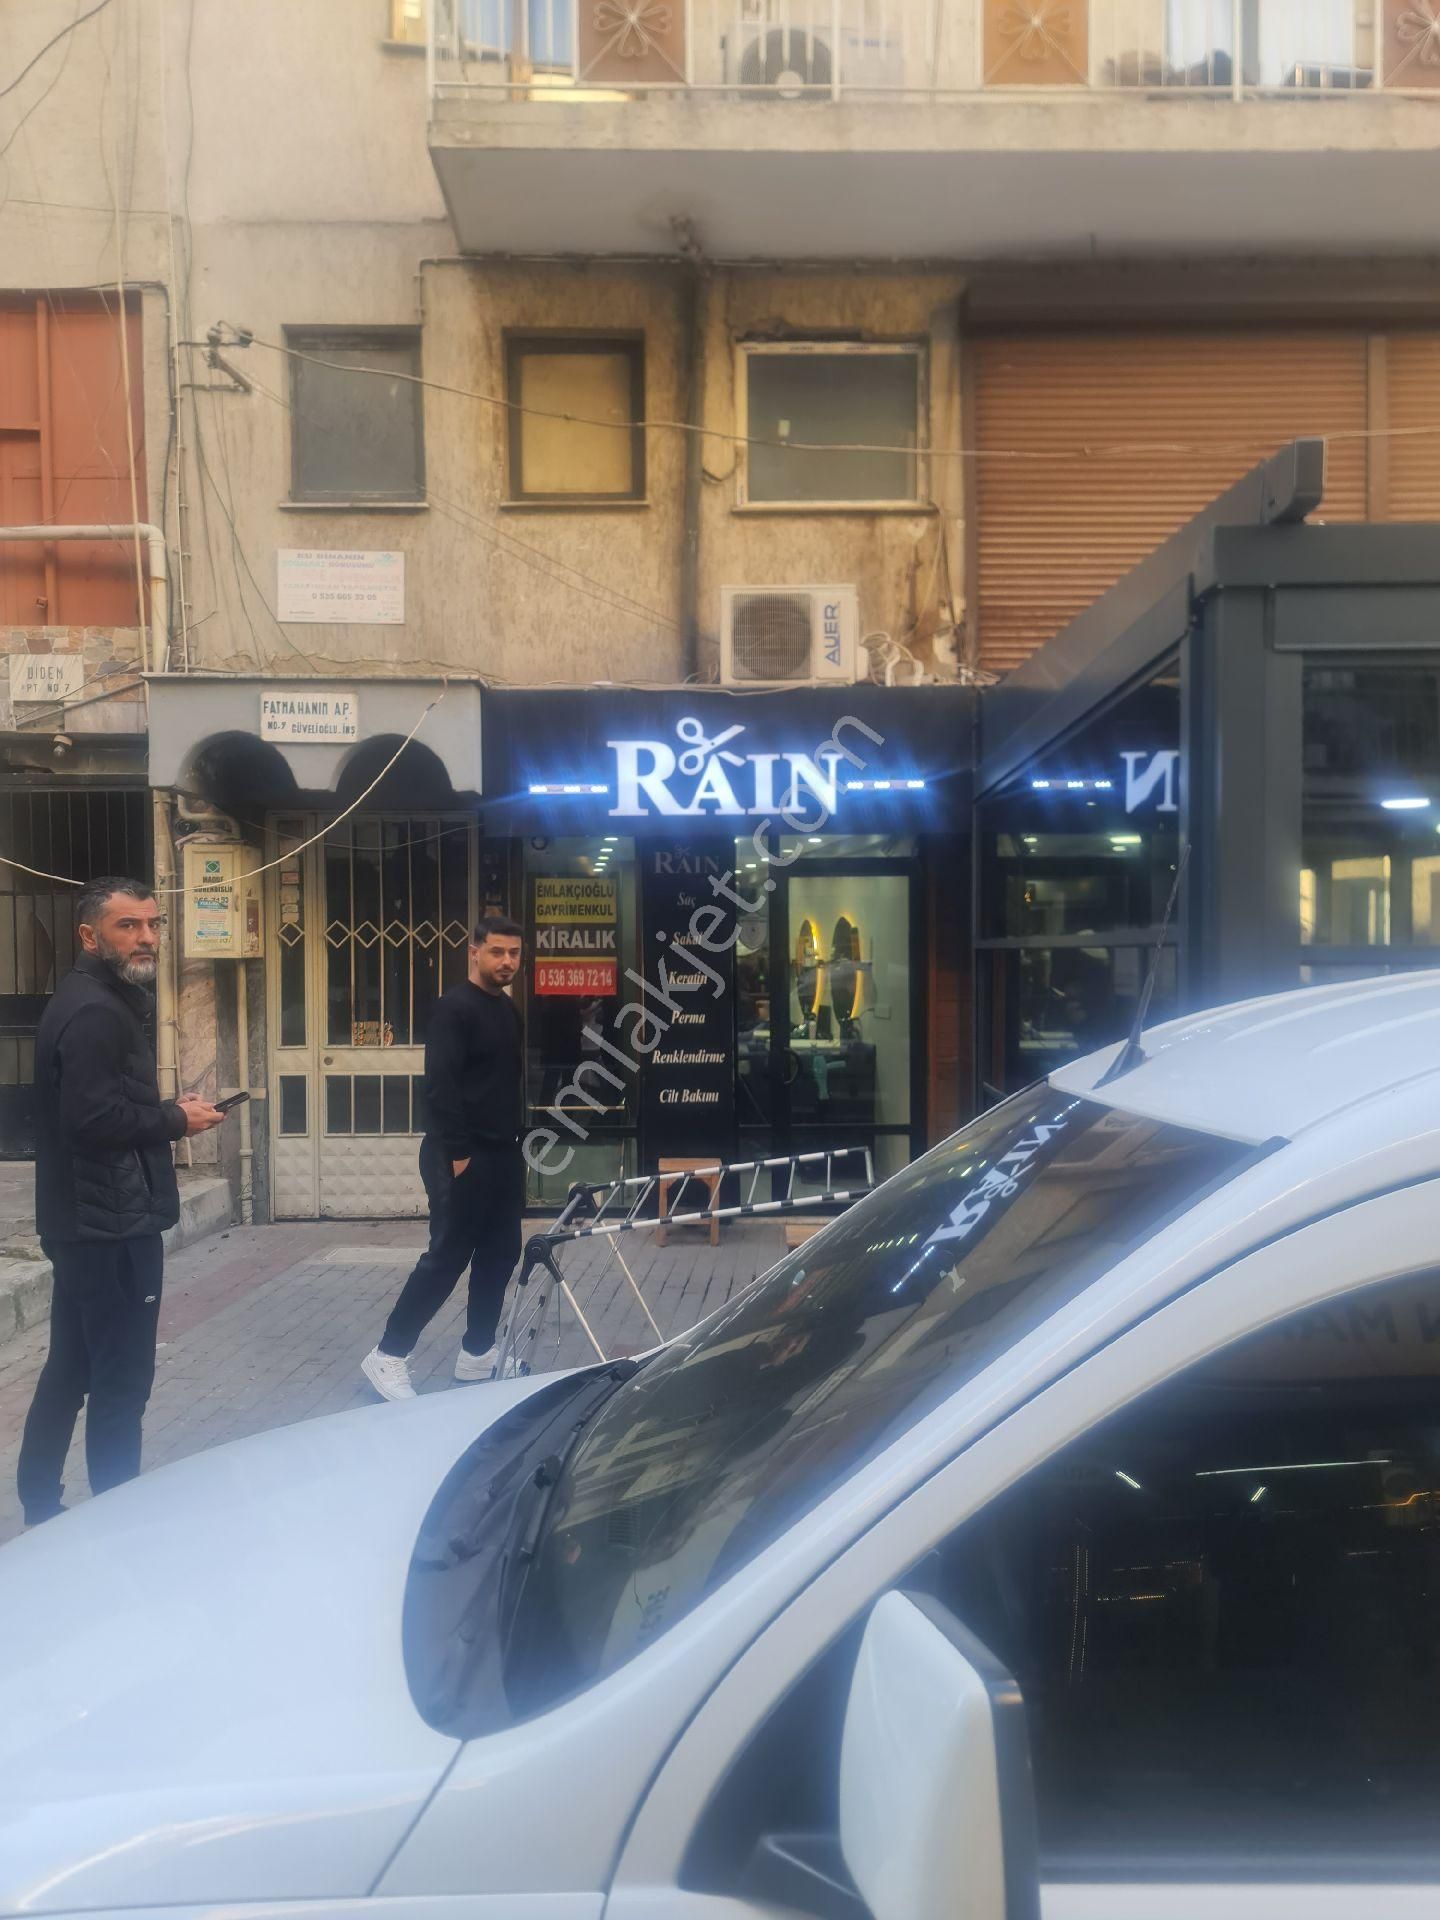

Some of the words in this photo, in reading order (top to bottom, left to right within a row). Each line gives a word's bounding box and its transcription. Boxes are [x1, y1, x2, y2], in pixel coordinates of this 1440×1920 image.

[824, 600, 841, 666] AUER
[47, 683, 59, 693] NO
[64, 683, 70, 692] 7
[263, 700, 296, 714] FATMA
[606, 740, 844, 817] RAIN
[654, 851, 720, 874] RAIN
[677, 892, 697, 908] Saç
[536, 903, 614, 916] GAYRİMENKUL
[536, 926, 616, 949] KİRALIK
[540, 969, 546, 986] 0
[548, 969, 565, 986] 536
[567, 969, 585, 986] 369
[587, 969, 599, 986] 72
[601, 969, 613, 986] 14
[668, 971, 708, 985] Keratin
[671, 1010, 706, 1024] Perma
[651, 1049, 726, 1064] Renklendirme
[659, 1089, 679, 1104] Cilt
[681, 1089, 720, 1103] Bakımı
